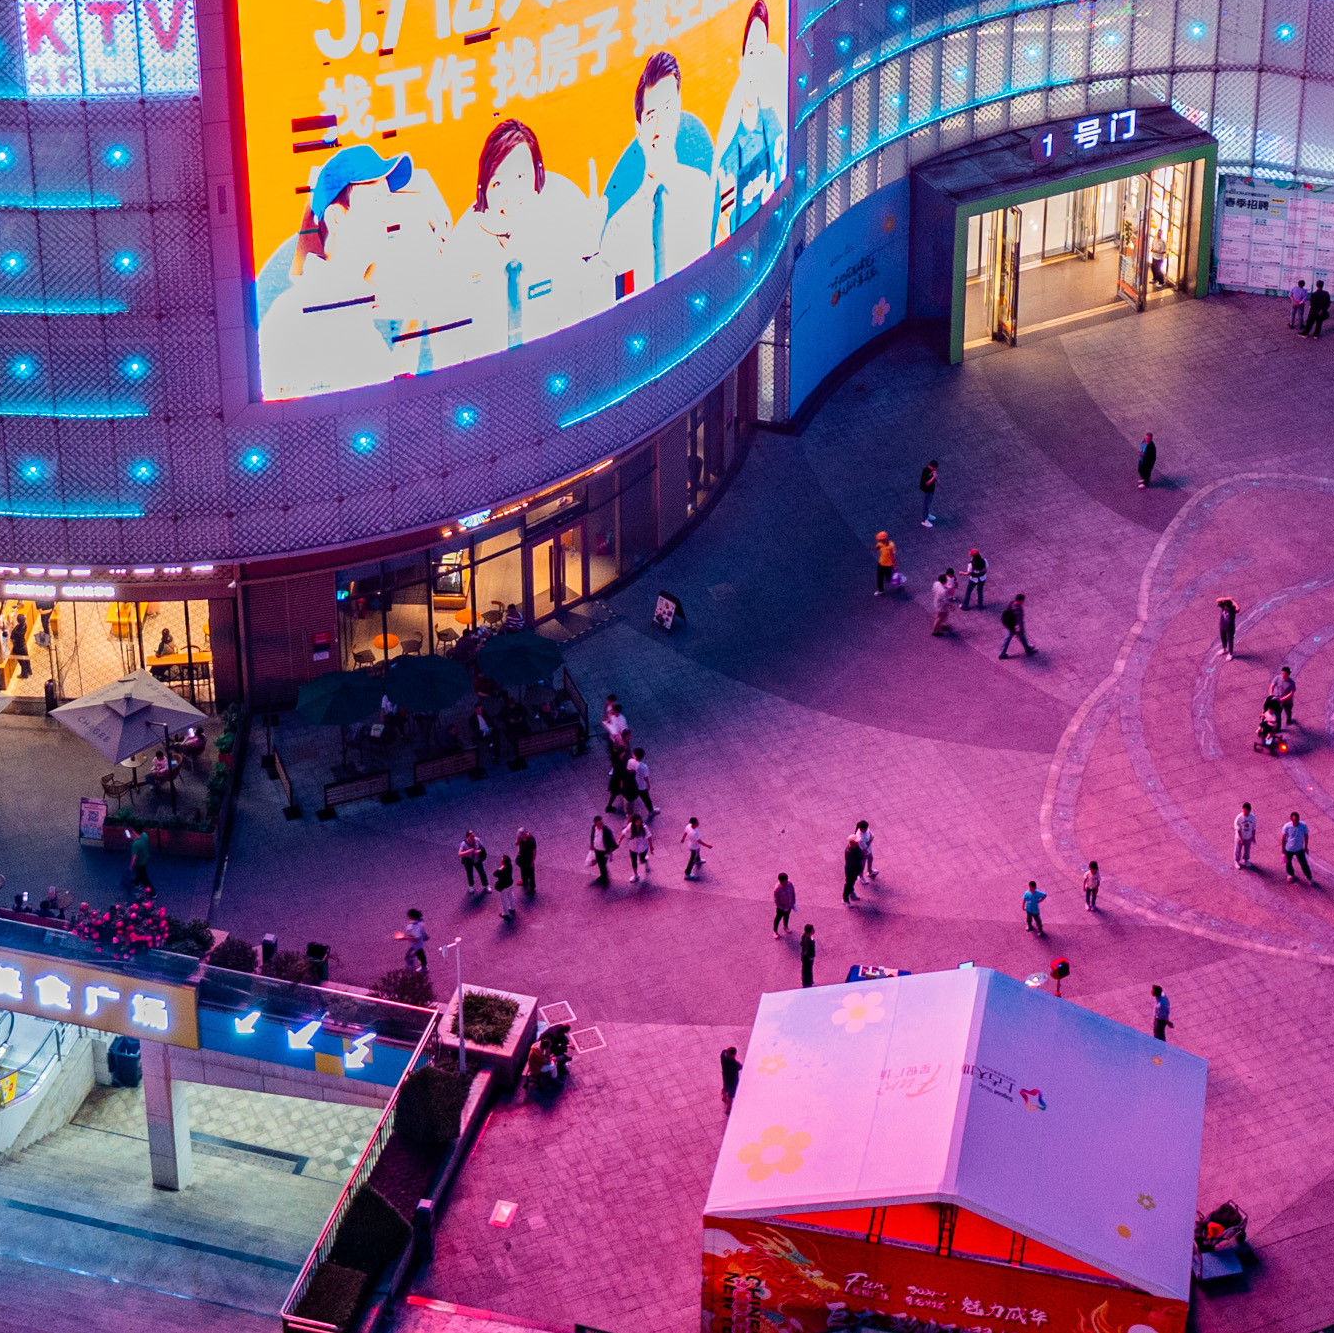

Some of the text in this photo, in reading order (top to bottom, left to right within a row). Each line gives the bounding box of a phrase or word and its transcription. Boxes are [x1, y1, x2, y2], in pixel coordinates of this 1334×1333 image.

[24, 1, 187, 56] KTV
[319, 55, 476, 140] 找工作
[491, 7, 622, 108] 找房子
[77, 715, 111, 743] CHAGEE
[844, 1272, 887, 1292] Fun
